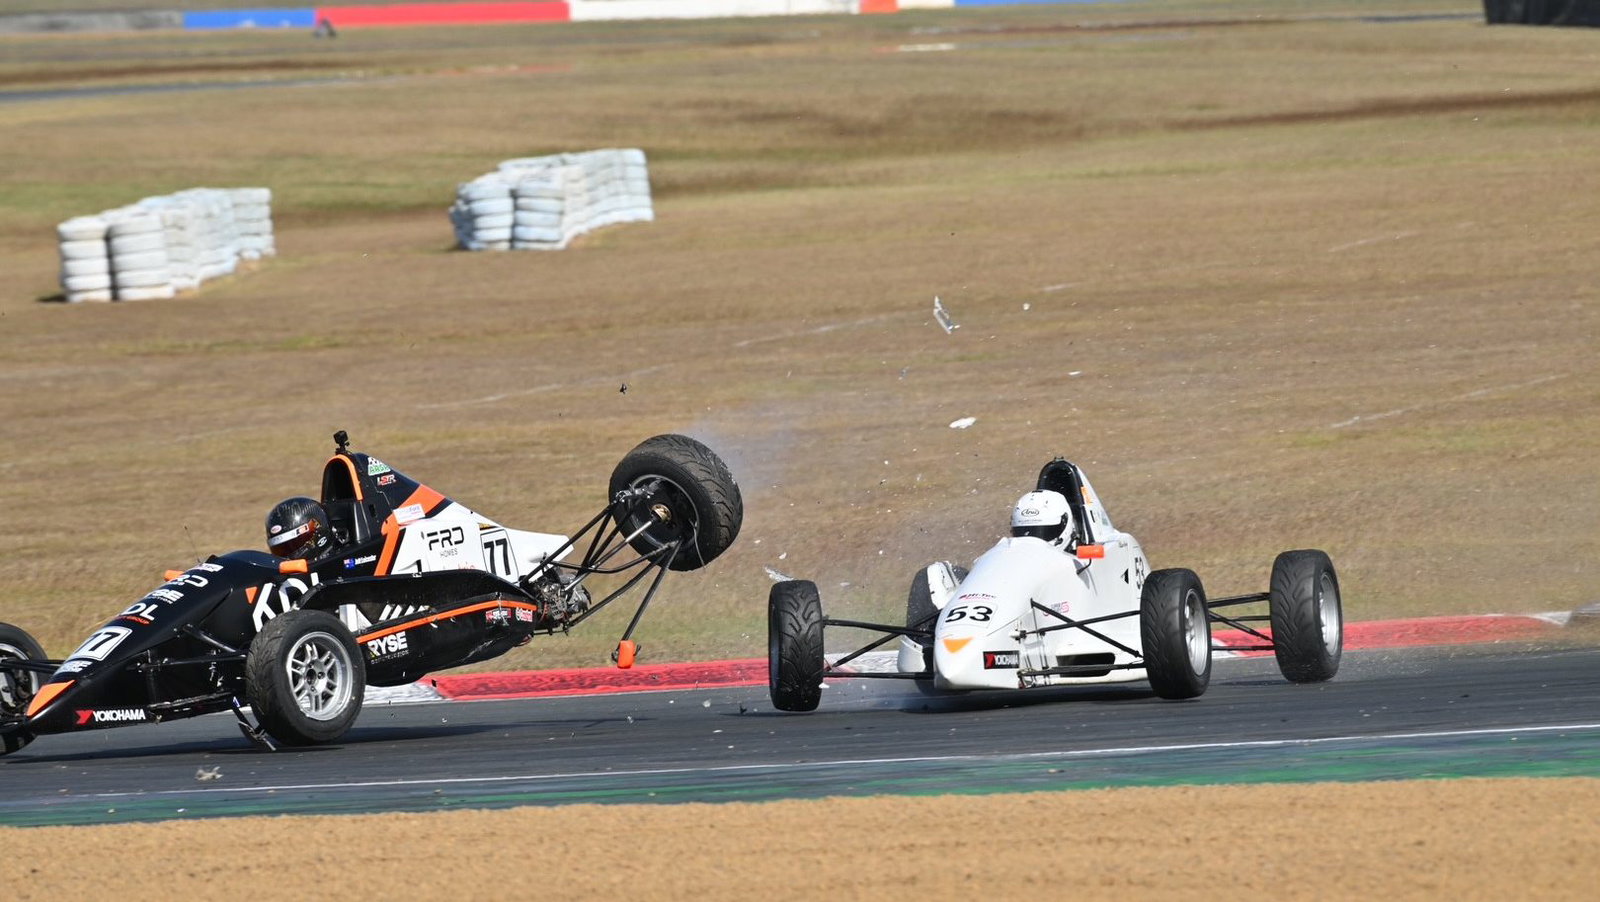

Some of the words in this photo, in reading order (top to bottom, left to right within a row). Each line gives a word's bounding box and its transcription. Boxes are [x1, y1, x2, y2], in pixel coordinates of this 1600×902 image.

[427, 526, 465, 551] FRD
[483, 538, 511, 576] 77
[252, 572, 320, 633] KD
[945, 605, 993, 623] 53
[367, 631, 408, 657] RYSE
[93, 708, 146, 722] YOKOHAMA
